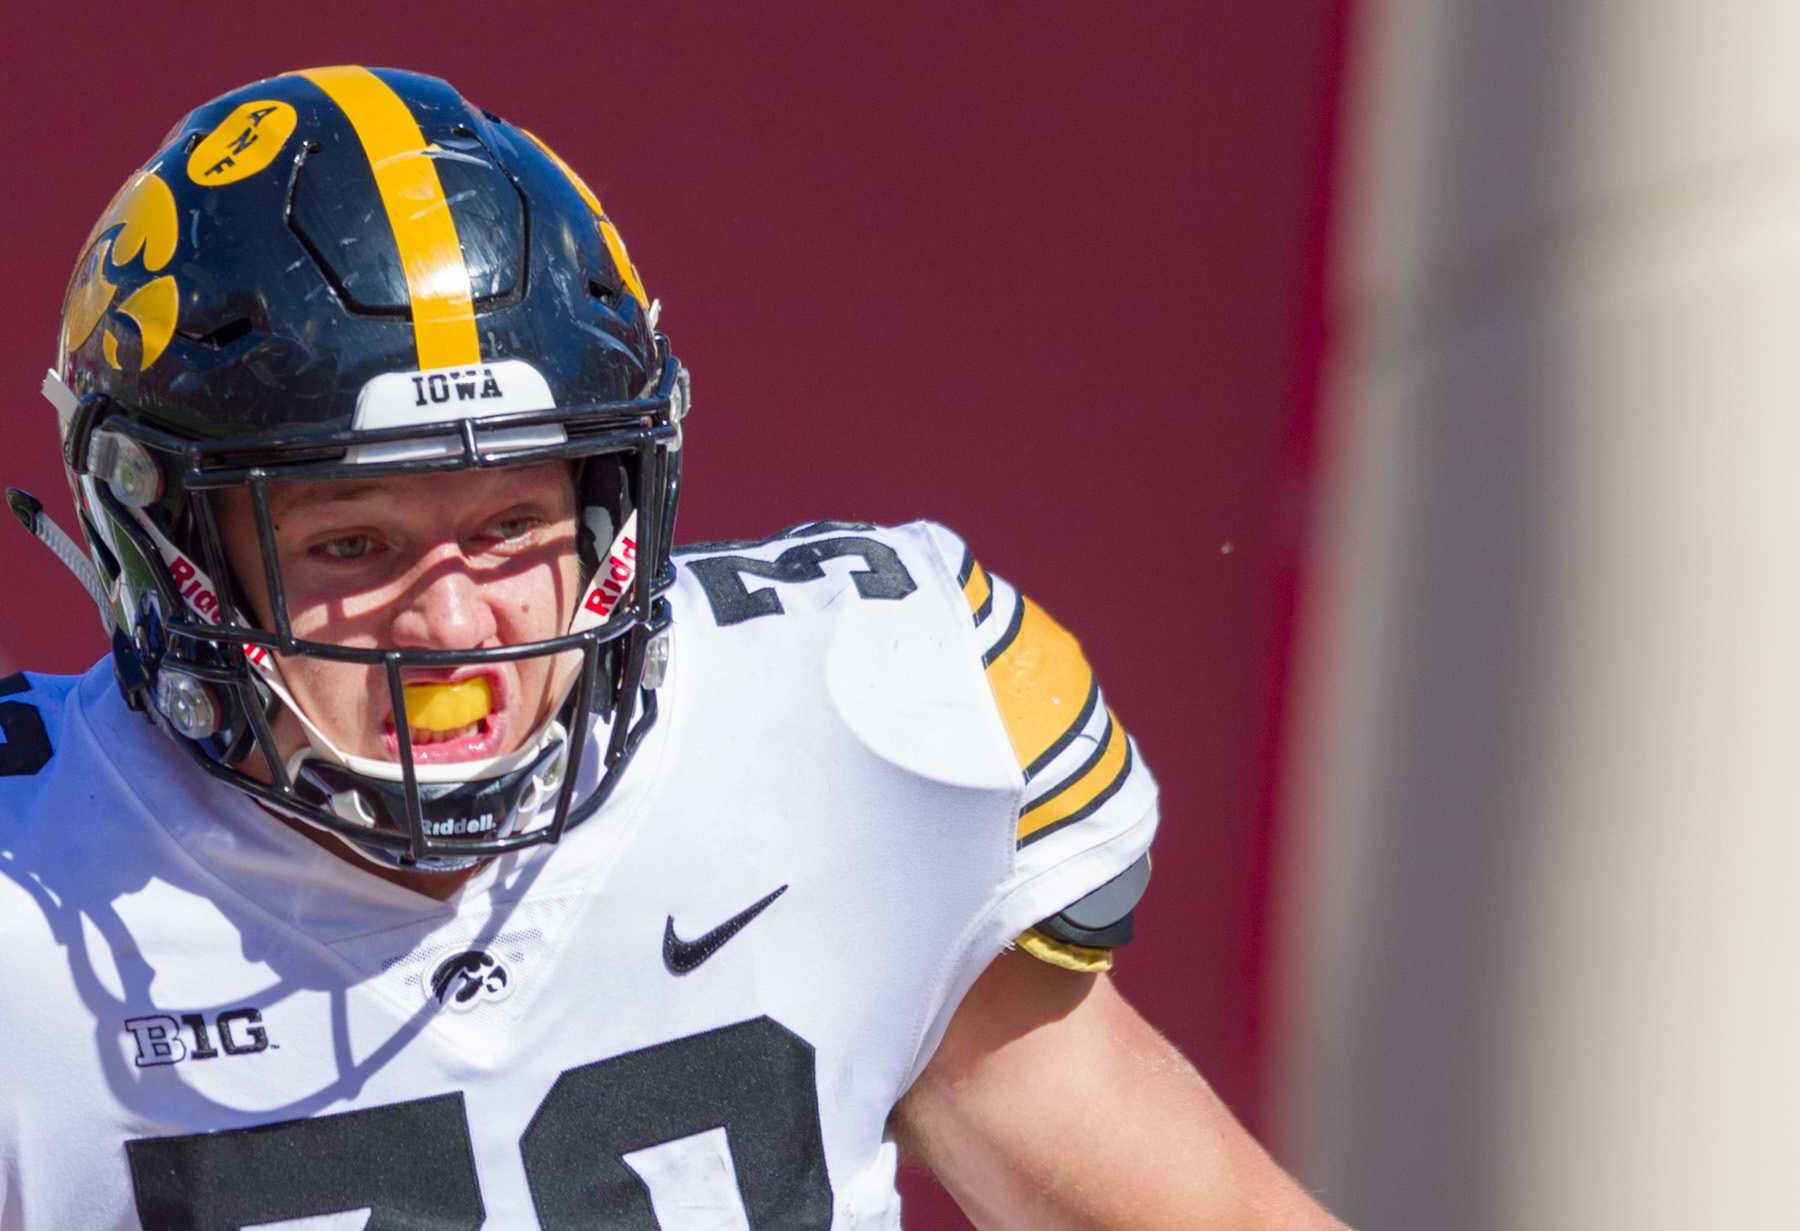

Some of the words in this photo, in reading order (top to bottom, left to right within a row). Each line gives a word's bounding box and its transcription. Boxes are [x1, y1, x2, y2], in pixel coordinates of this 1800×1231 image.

[203, 106, 277, 176] ANF
[411, 369, 503, 406] IOWA
[671, 519, 918, 626] 3
